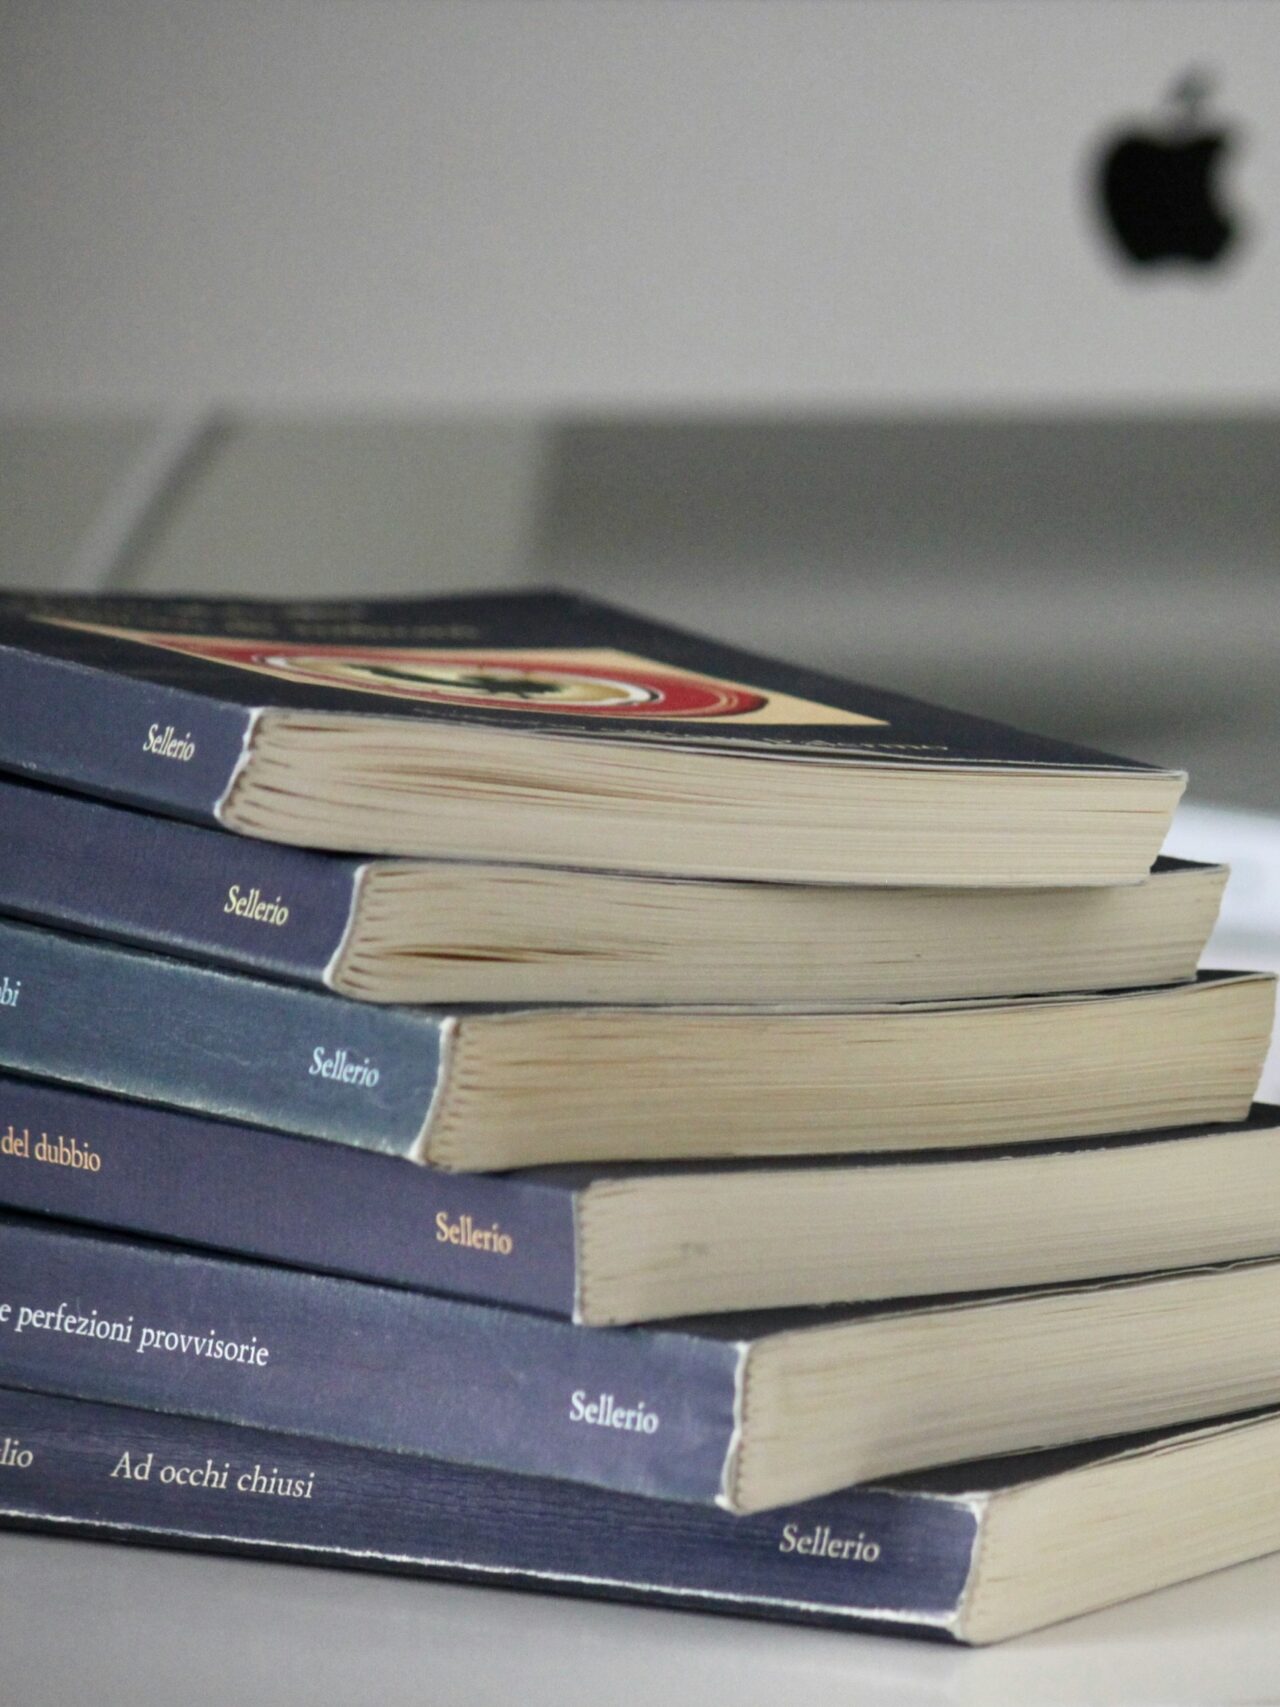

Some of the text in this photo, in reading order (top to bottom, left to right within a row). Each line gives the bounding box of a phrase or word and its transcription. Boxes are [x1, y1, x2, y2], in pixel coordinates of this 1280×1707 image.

[143, 724, 195, 762] Sellerio
[224, 885, 289, 926] Sellerio
[0, 976, 21, 1007] bi
[309, 1047, 380, 1088] Sellerio
[1, 1126, 101, 1172] del dubbio
[436, 1212, 513, 1255] Sellerio
[14, 1302, 134, 1343] perfezioni
[136, 1327, 270, 1367] provvisorie
[570, 1390, 660, 1434] Sellerio
[110, 1451, 315, 1500] Ad occhi chiusi
[779, 1524, 881, 1563] Sellerio
